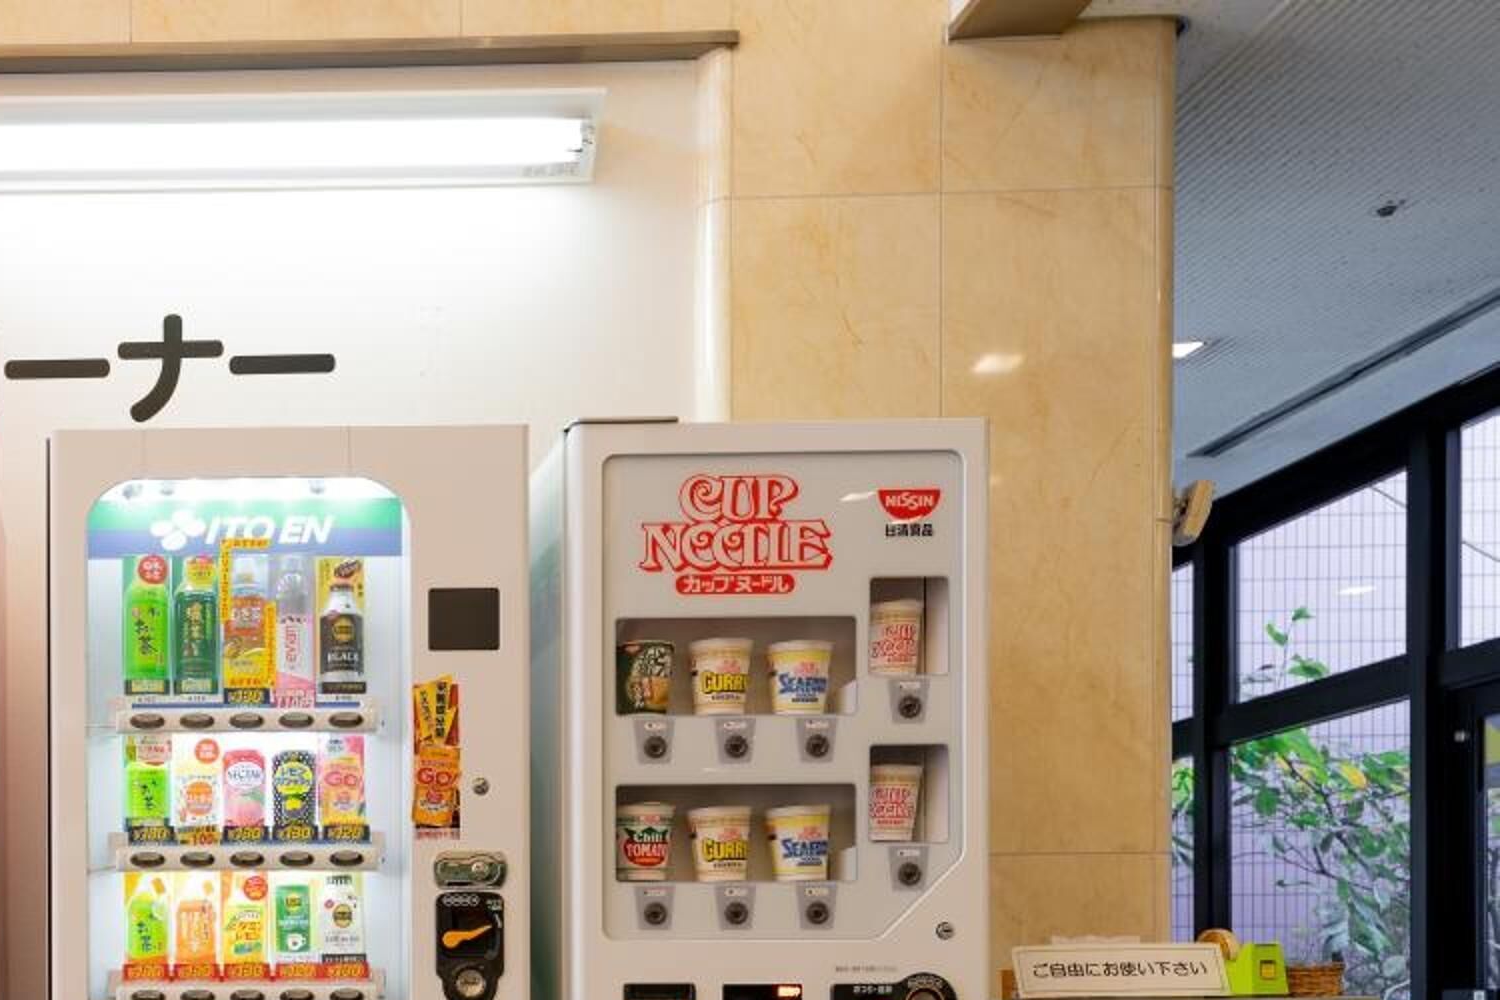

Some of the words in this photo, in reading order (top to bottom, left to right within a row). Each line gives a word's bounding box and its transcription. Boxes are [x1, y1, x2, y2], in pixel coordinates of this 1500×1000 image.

[678, 474, 799, 522] CUP
[885, 494, 934, 508] NISSIN
[205, 516, 271, 544] ITO
[278, 516, 333, 544] EN
[885, 523, 934, 537] 日清食品
[1033, 960, 1208, 978] ご自由にお使い下さい
